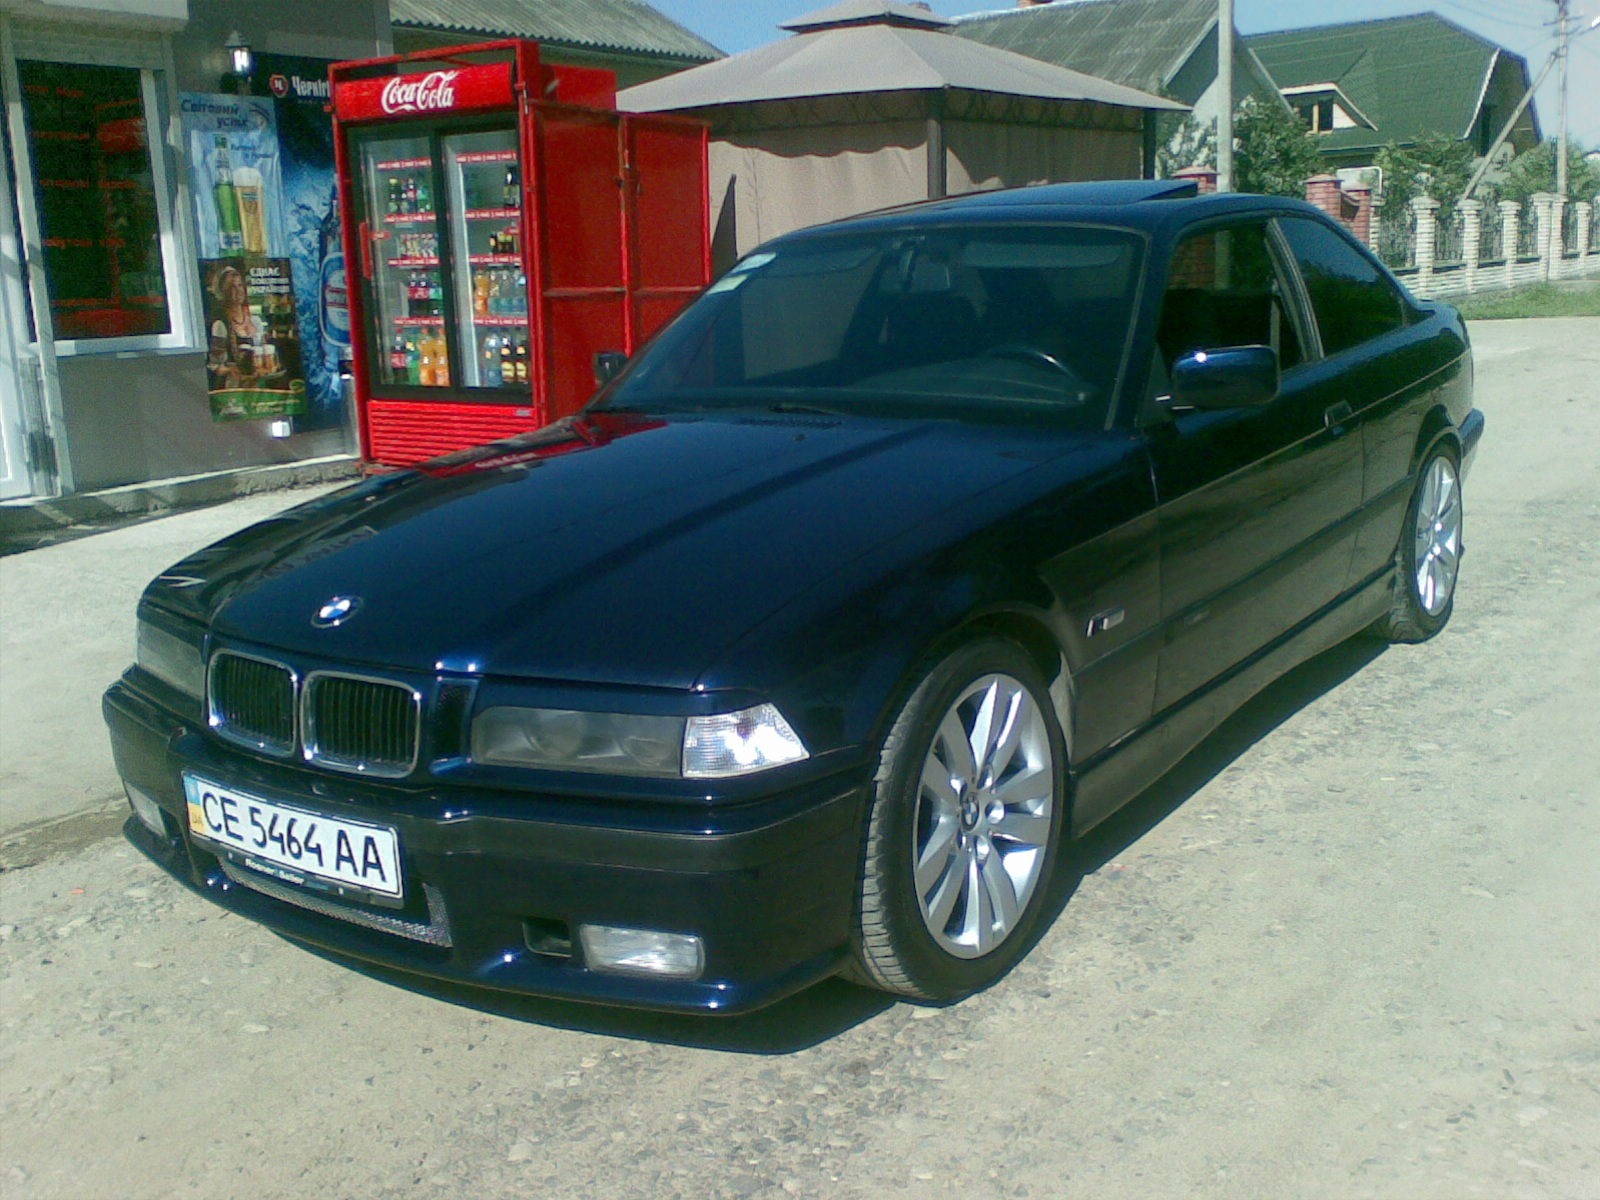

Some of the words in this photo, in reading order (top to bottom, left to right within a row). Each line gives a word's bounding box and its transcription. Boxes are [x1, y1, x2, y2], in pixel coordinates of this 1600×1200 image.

[180, 99, 239, 115] Світовий
[202, 791, 243, 842] CE
[249, 806, 324, 867] 5464
[335, 829, 388, 883] AA
